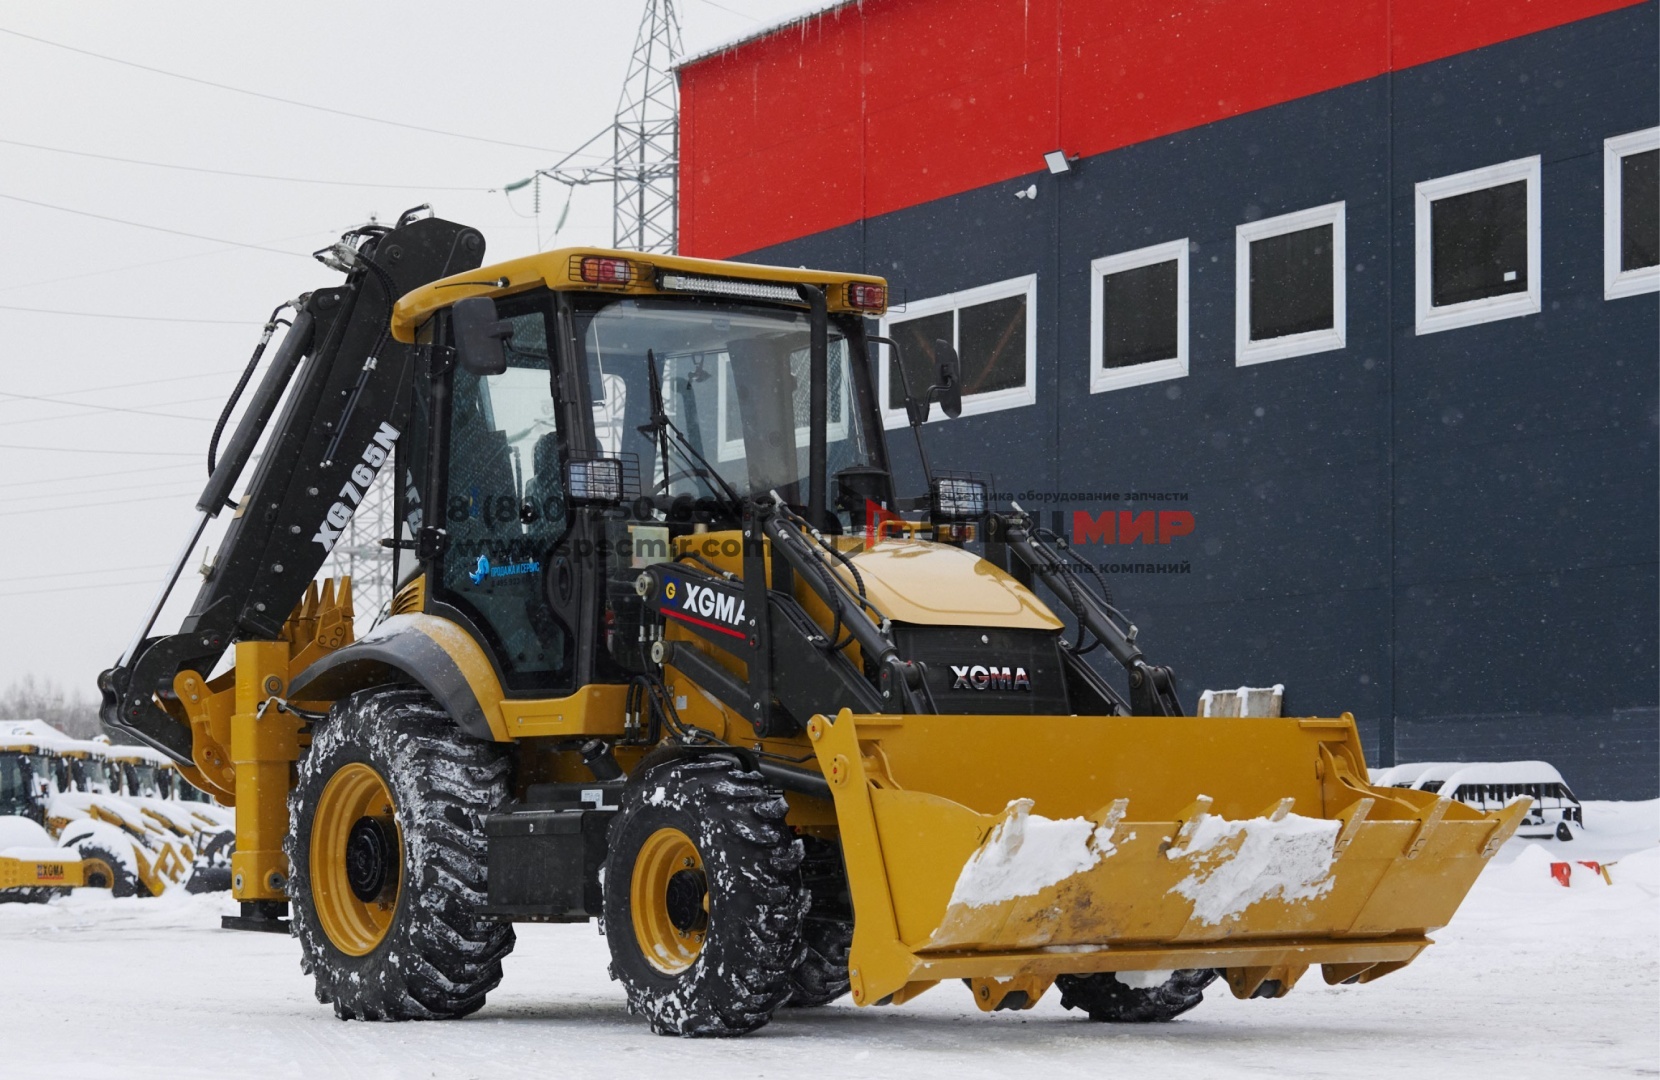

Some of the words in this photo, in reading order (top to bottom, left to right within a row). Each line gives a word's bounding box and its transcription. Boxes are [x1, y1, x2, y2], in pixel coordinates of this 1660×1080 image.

[312, 421, 400, 552] XG765N
[491, 564, 515, 577] ПРОДАЖА
[520, 561, 540, 574] СЕРВИС
[950, 664, 1032, 691] XGMA
